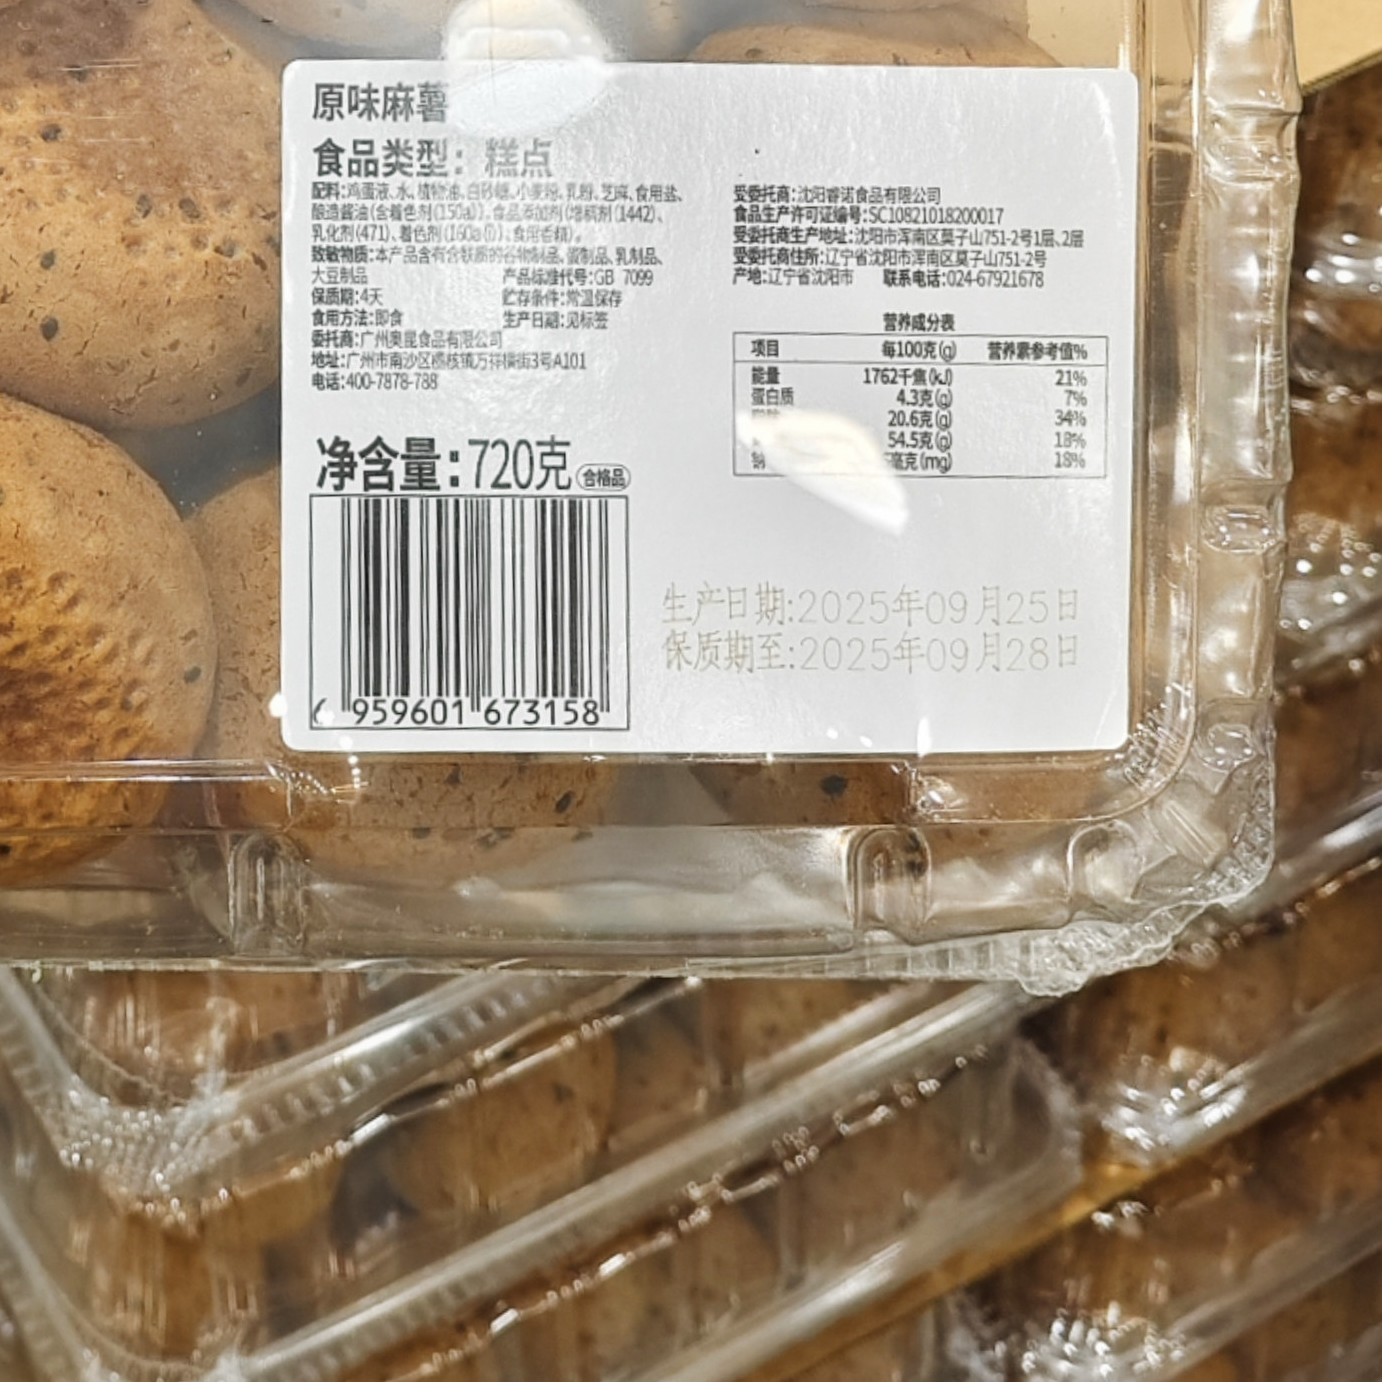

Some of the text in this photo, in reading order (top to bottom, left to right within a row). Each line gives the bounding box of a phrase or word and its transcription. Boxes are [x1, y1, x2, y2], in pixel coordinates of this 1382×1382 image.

[311, 266, 368, 285] 大豆制品
[624, 270, 654, 287] 7099
[733, 268, 854, 286] 产地:辽宁省沈阳市
[883, 313, 955, 332] 营养成分表
[751, 339, 779, 358] 项目
[751, 366, 780, 385] 能量
[1055, 370, 1087, 387] 21%
[751, 387, 794, 406] 蛋白质
[1064, 391, 1087, 407] 7%
[1054, 410, 1086, 427] 34%
[316, 435, 571, 492] 净含量:720克
[1054, 452, 1086, 469] 18%
[581, 468, 626, 488] 合格品
[352, 698, 465, 725] 959601
[484, 699, 600, 726] 673158
